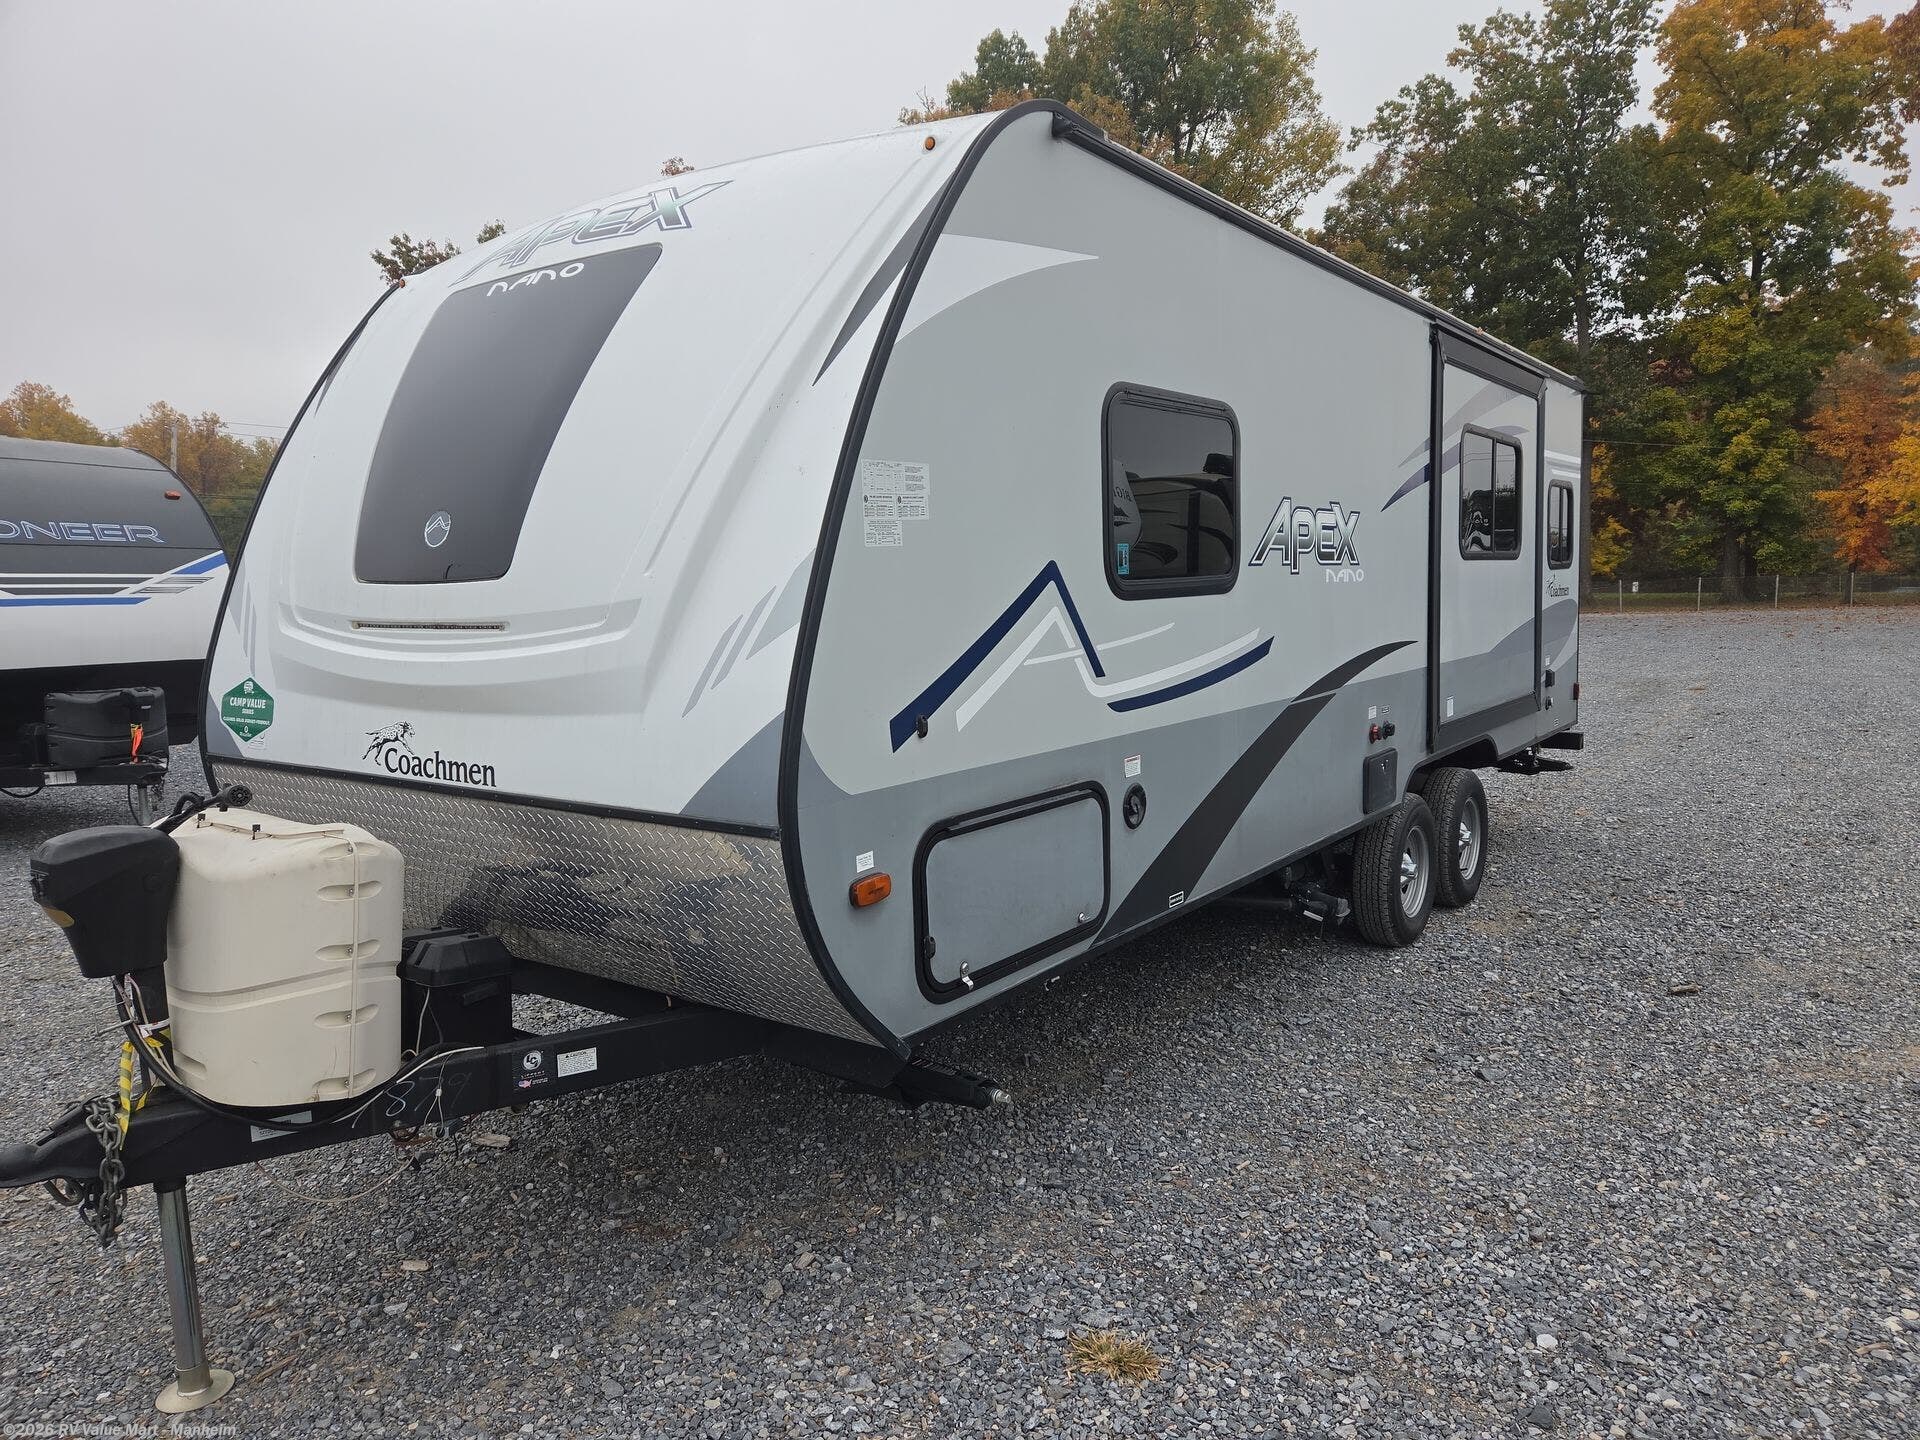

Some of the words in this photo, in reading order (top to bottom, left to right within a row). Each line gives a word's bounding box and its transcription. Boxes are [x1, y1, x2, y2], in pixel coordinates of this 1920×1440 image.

[448, 179, 734, 288] APEX
[1248, 496, 1360, 575] APEX
[1325, 568, 1365, 583] NANO
[384, 747, 497, 787] Coachmen
